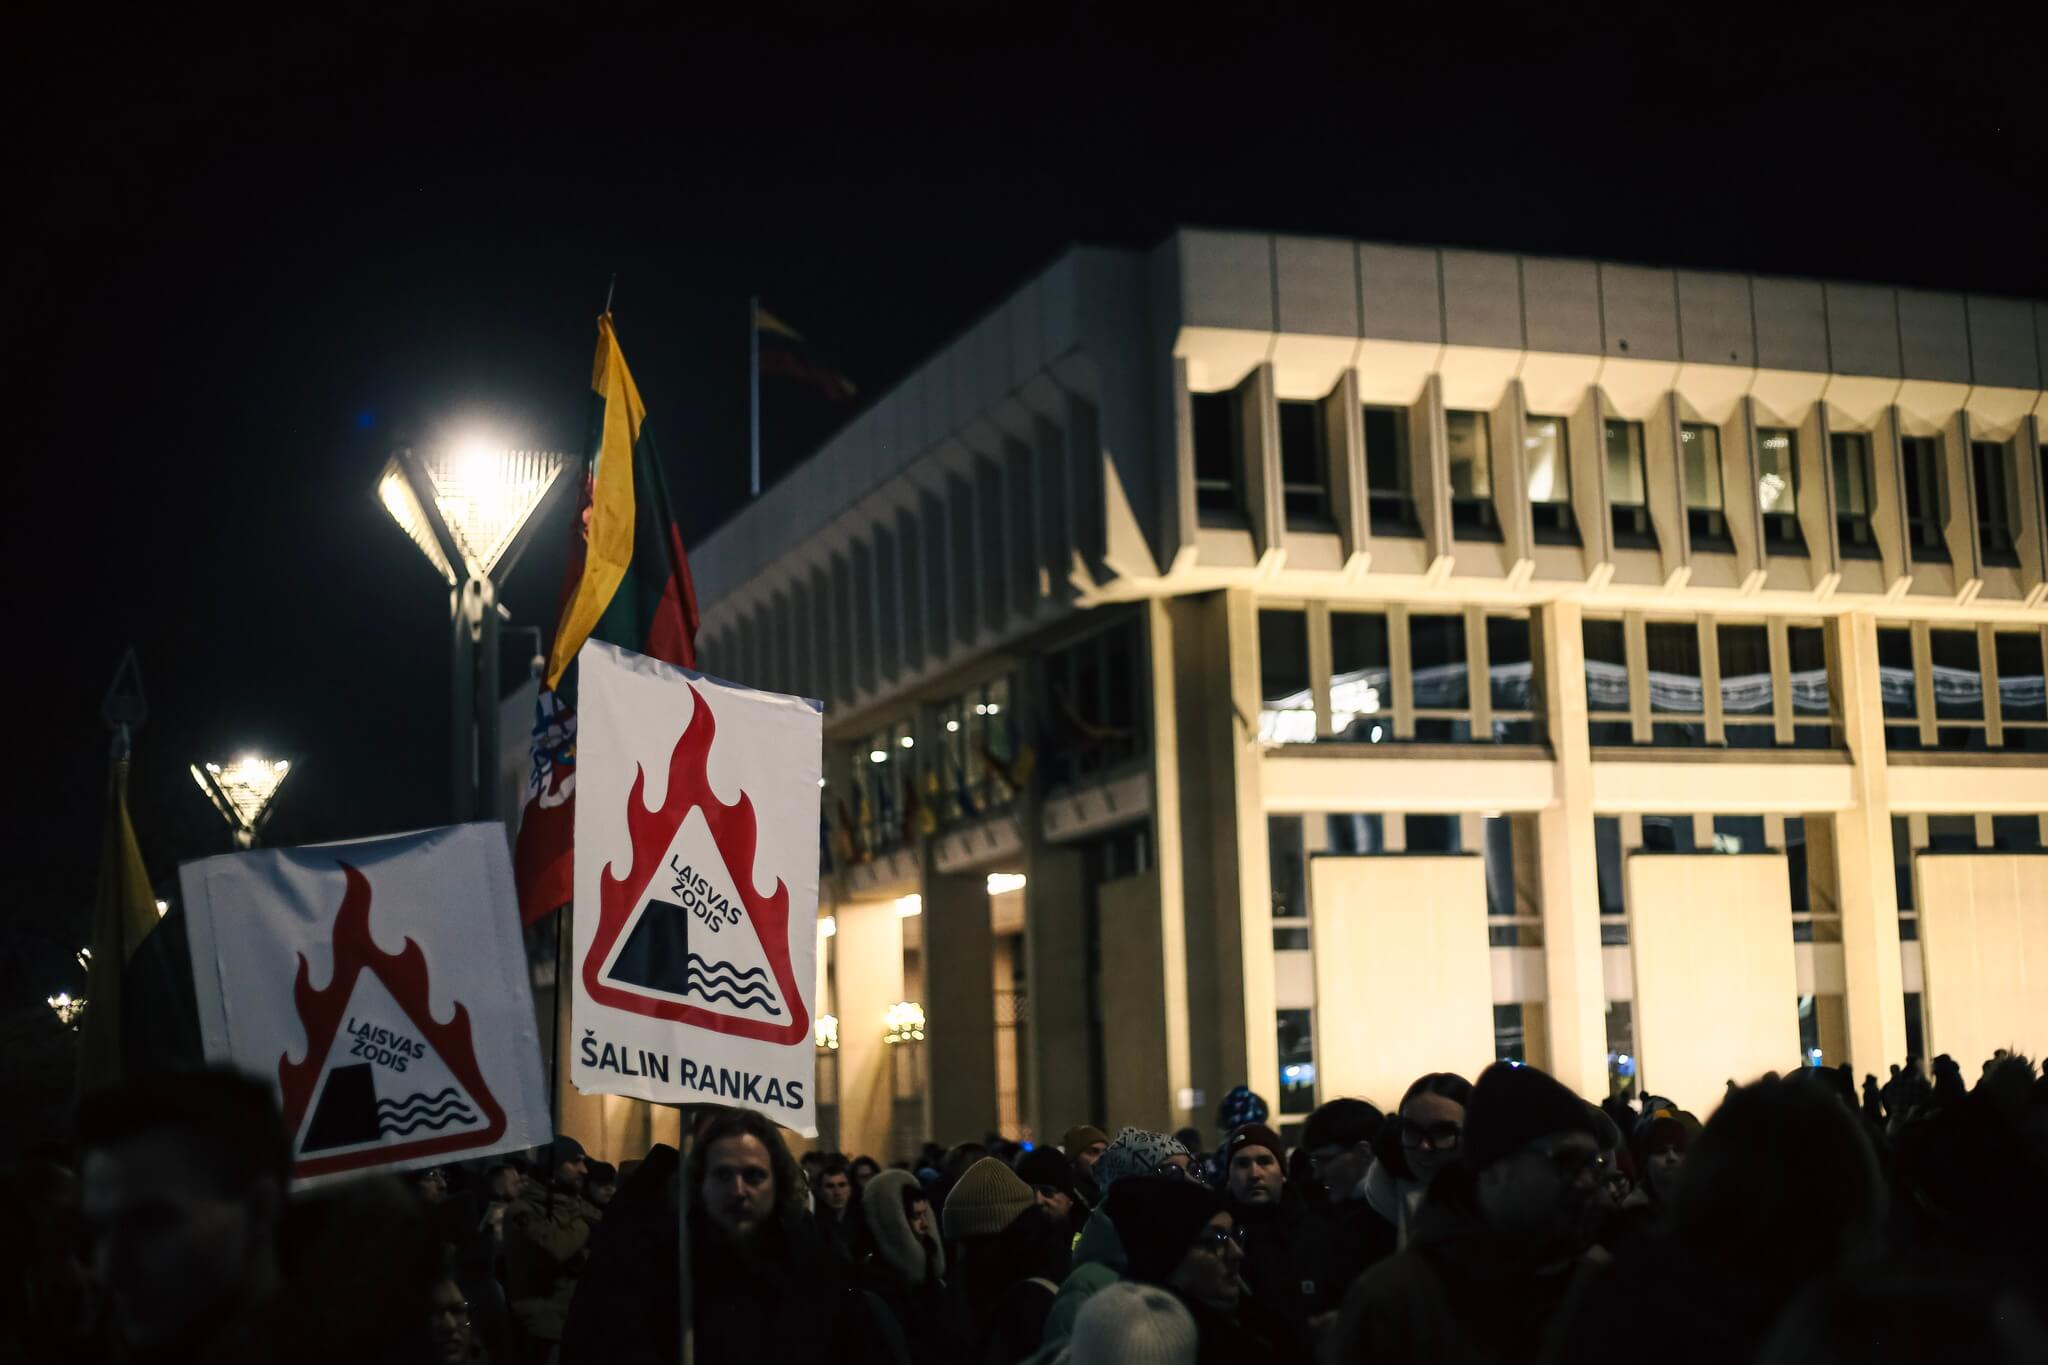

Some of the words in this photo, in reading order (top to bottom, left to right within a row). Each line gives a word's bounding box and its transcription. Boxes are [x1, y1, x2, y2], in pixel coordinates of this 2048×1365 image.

[670, 854, 742, 925] LAISVAS
[671, 876, 723, 933] ŽODIS
[347, 1017, 426, 1059] LAISVAS
[350, 1036, 409, 1072] ŽODIS
[581, 1029, 669, 1083] ŠALIN
[680, 1058, 804, 1109] RANKAS
